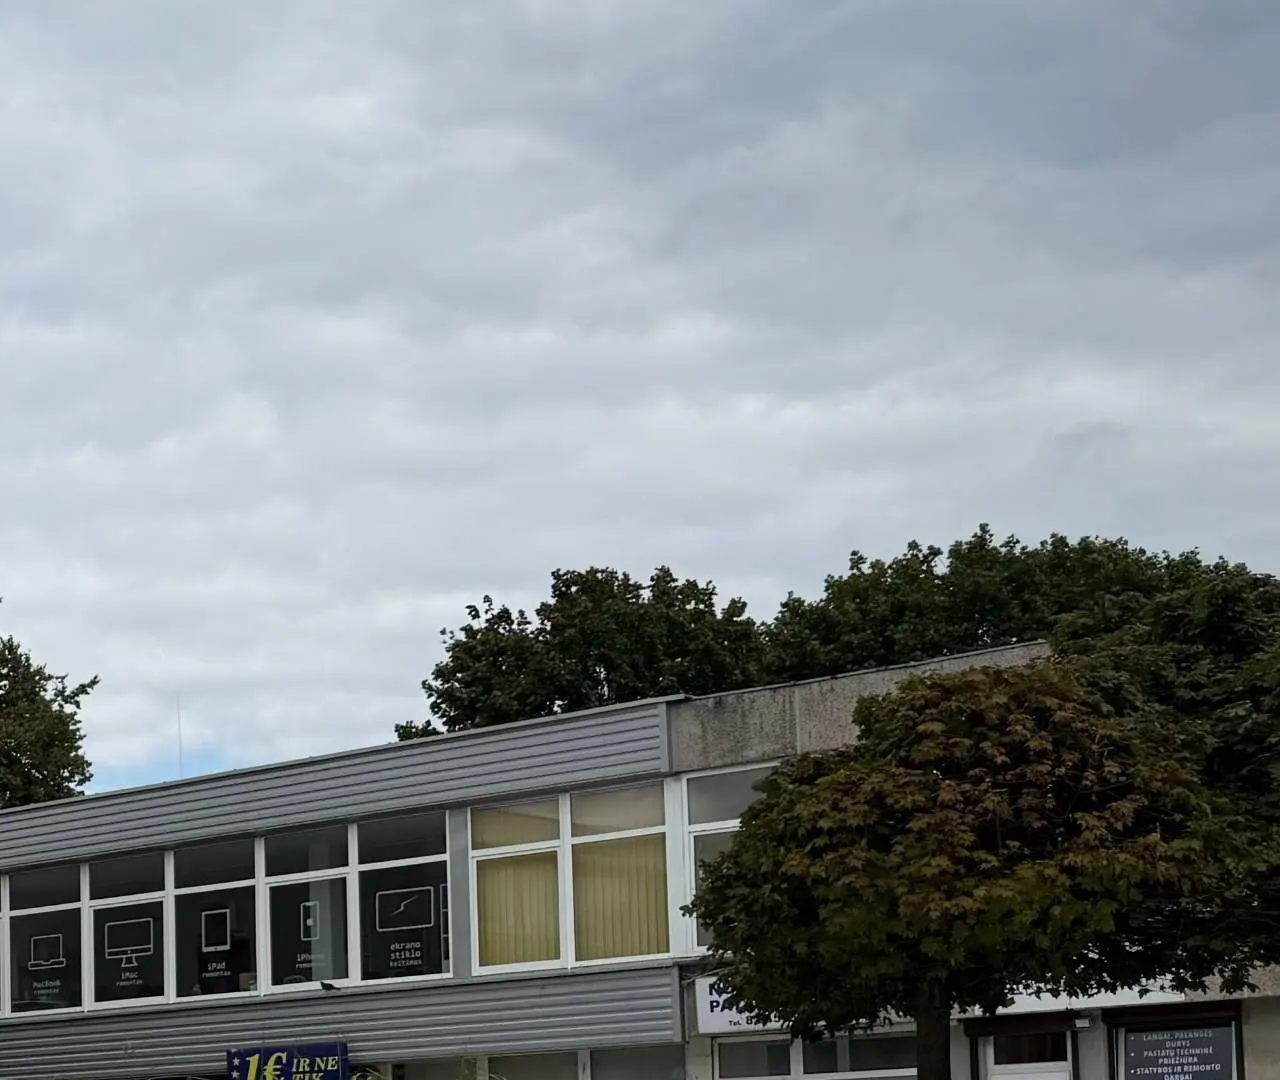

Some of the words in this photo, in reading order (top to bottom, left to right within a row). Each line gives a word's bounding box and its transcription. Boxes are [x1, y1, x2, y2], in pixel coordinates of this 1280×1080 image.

[390, 941, 421, 951] ekrano
[390, 949, 421, 960] stiklo
[207, 961, 226, 971] iPad
[1165, 1040, 1191, 1048] DURYS
[1143, 1049, 1175, 1058] PASTATŲ
[291, 1057, 311, 1072] IR
[314, 1056, 339, 1071] NE
[1136, 1066, 1173, 1075] STATYBOS
[1183, 1063, 1221, 1073] REMONTO
